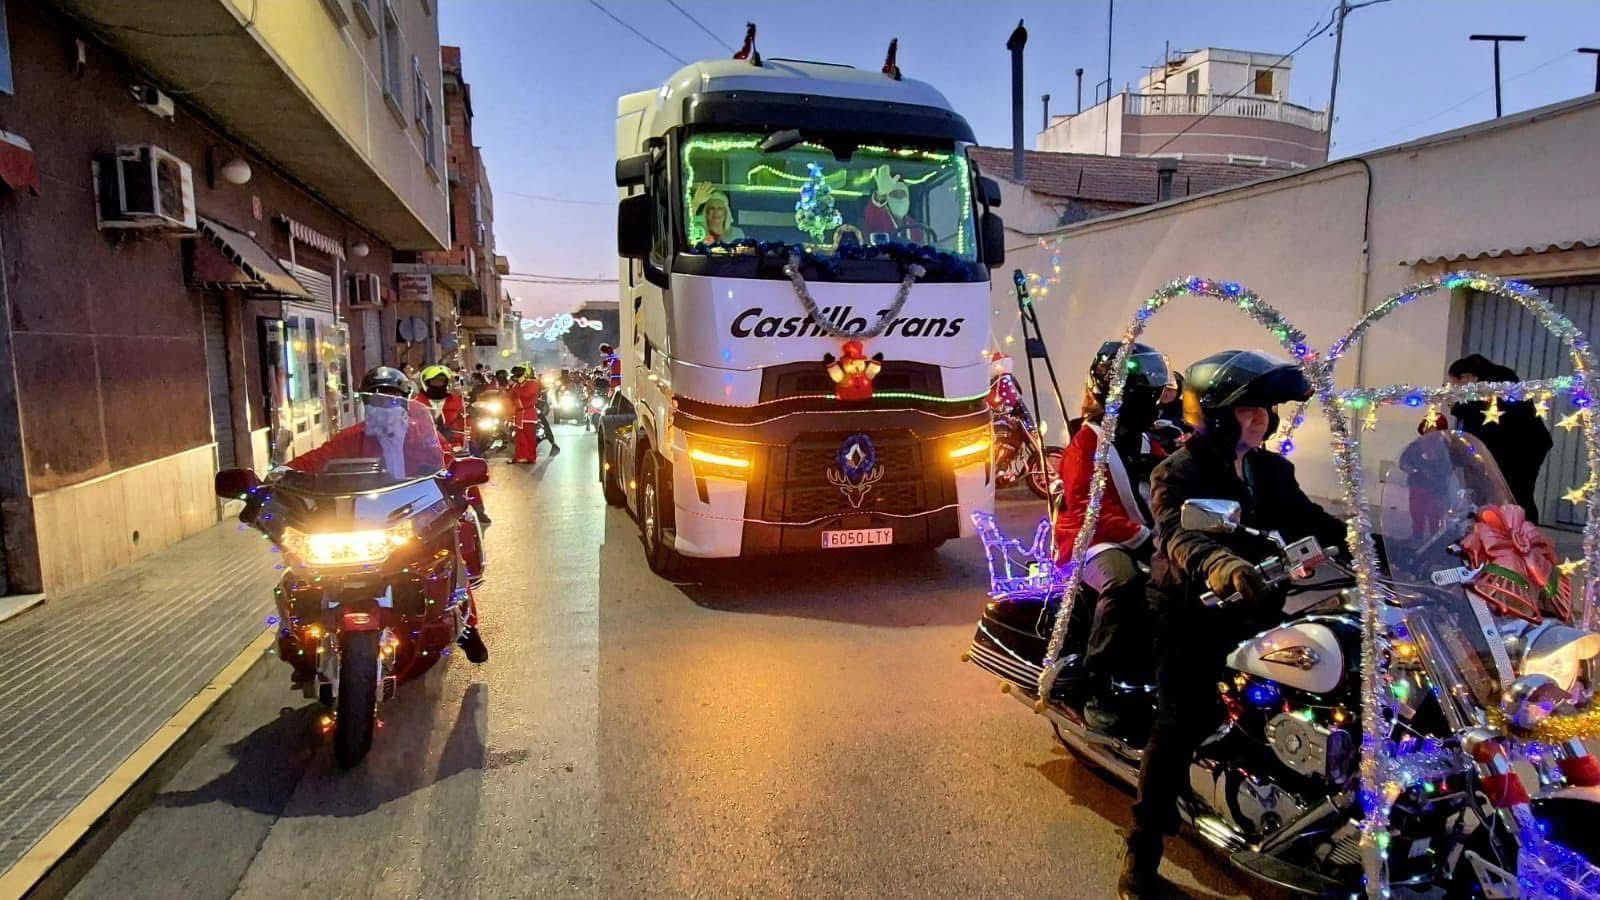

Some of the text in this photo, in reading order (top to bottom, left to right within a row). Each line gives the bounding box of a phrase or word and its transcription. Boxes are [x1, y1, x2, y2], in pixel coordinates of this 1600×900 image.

[730, 305, 867, 338] Castillo
[831, 530, 890, 545] 6050 LTY
